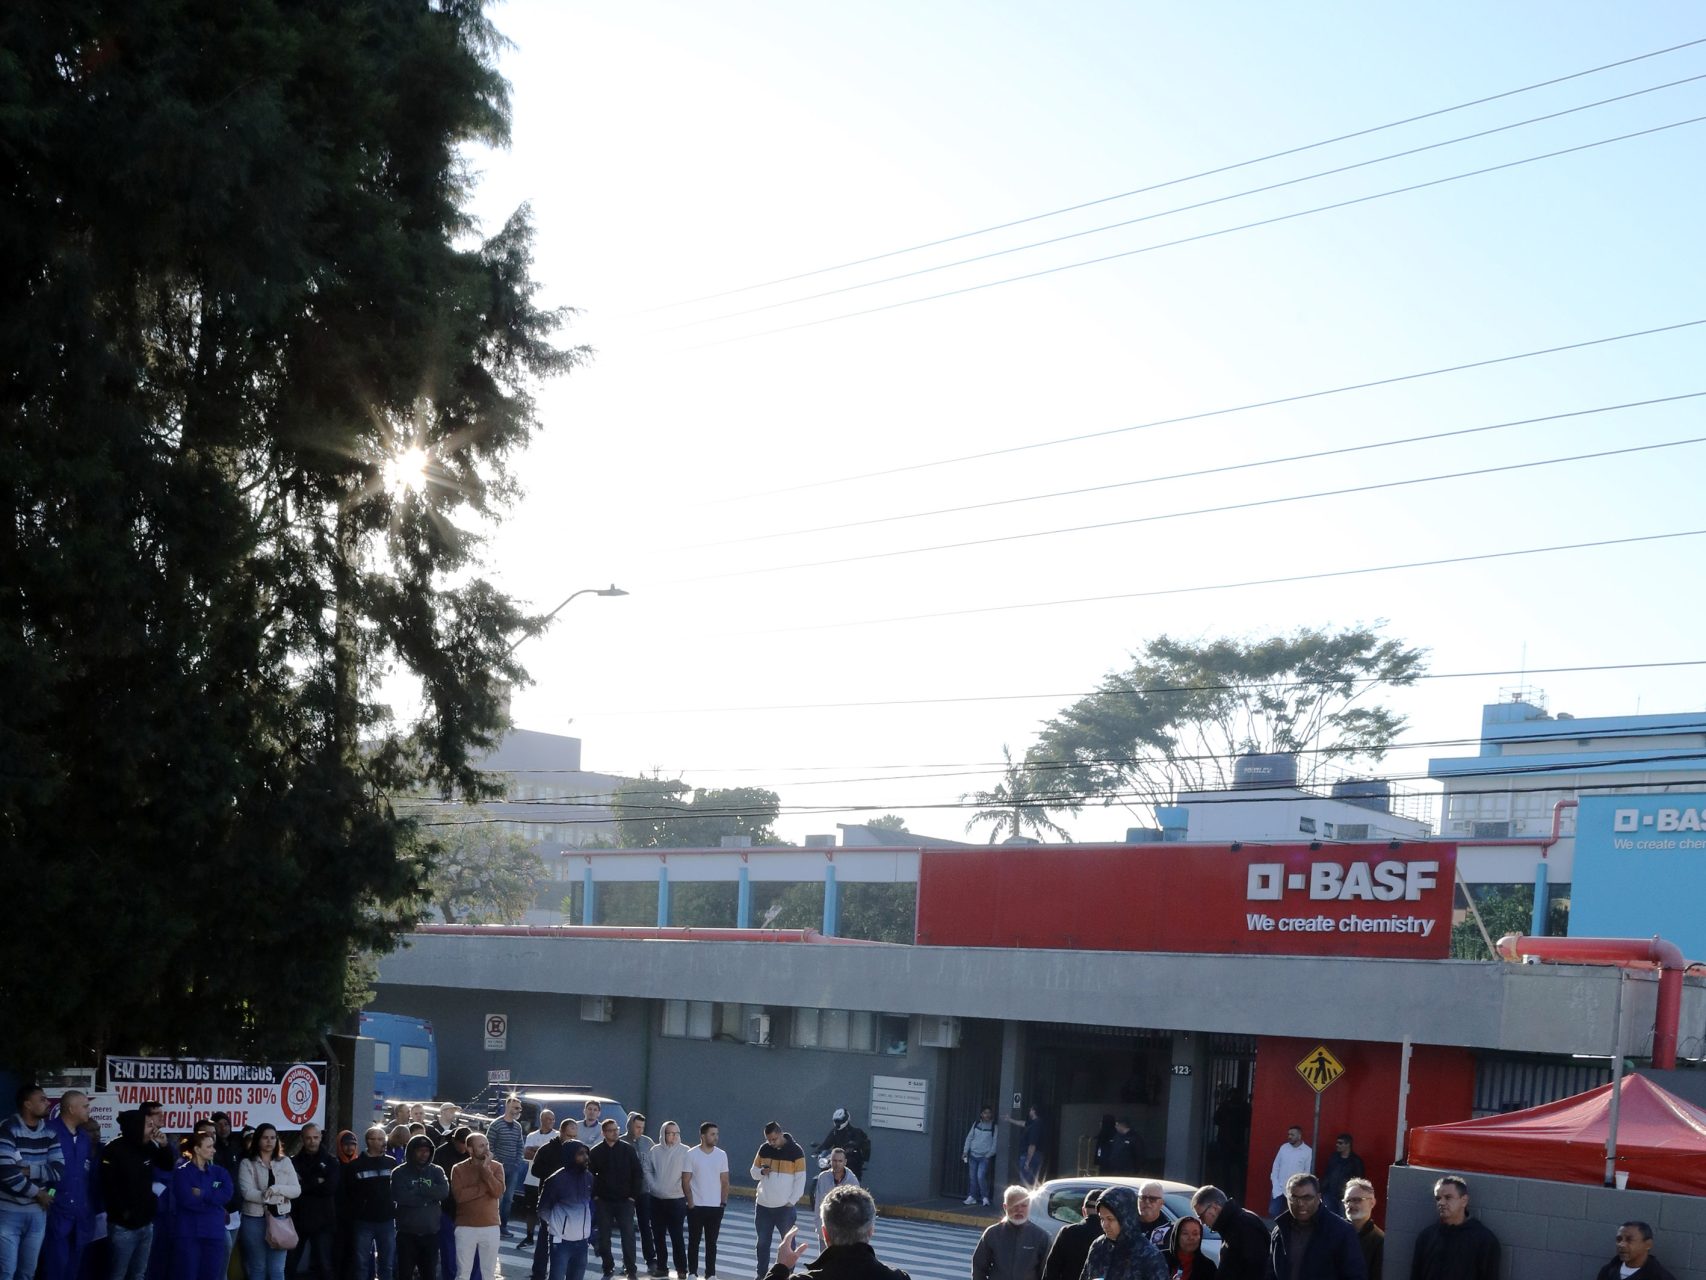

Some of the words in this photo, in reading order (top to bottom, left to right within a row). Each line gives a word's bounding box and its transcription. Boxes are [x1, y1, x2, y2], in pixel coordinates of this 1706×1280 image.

[1657, 808, 1706, 832] BA
[1614, 839, 1633, 850] We
[1636, 839, 1676, 850] create
[1309, 860, 1439, 902] BASF
[1246, 914, 1275, 931] We
[1278, 915, 1336, 932] create
[1338, 914, 1436, 937] chemistry
[115, 1063, 135, 1080] EM
[138, 1064, 183, 1081] DEFESA
[186, 1065, 210, 1081] DOS
[1174, 1065, 1189, 1075] 123
[116, 1083, 213, 1108] MANUTENÇÃO
[216, 1087, 243, 1105] DOS
[246, 1087, 277, 1105] 30%
